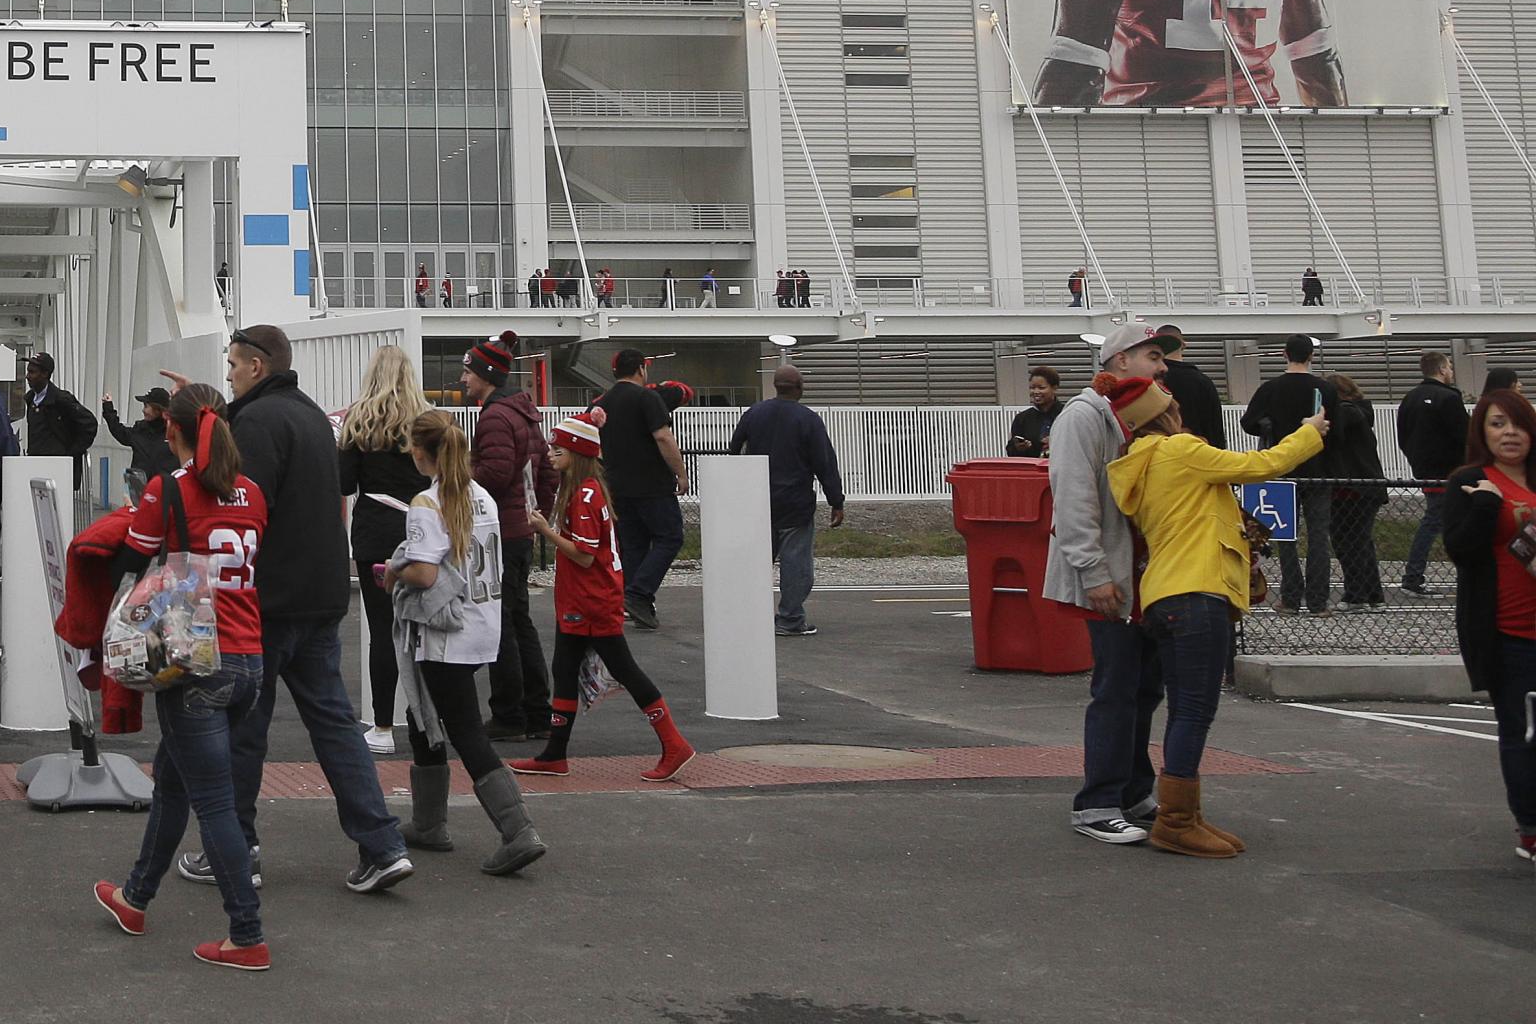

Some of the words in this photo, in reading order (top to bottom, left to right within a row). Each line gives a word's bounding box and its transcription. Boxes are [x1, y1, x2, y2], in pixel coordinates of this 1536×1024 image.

[7, 41, 70, 81] BE
[89, 42, 216, 83] FREE
[581, 487, 595, 504] 7
[207, 528, 258, 591] 21
[467, 532, 502, 605] 21
